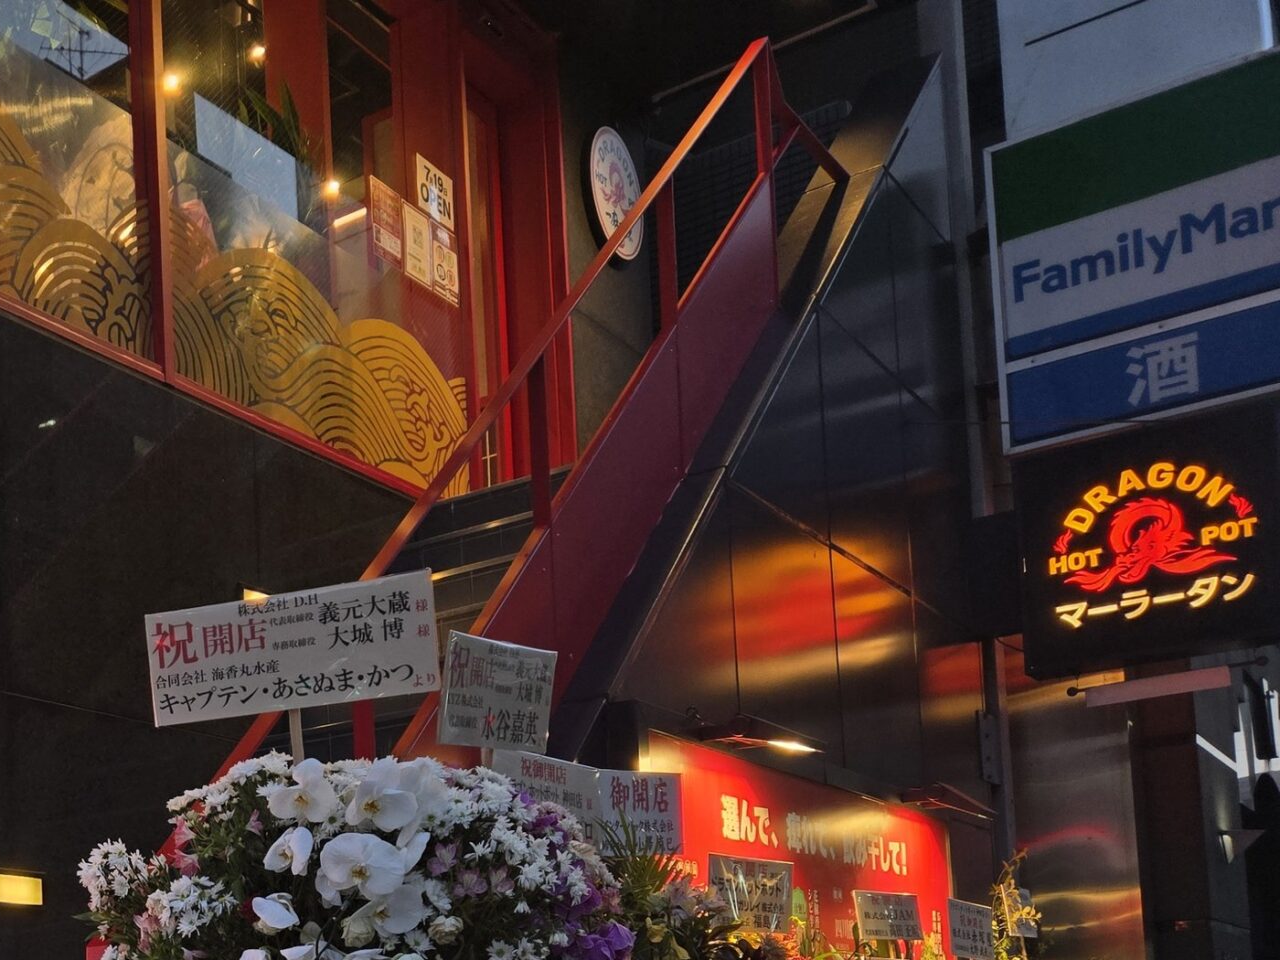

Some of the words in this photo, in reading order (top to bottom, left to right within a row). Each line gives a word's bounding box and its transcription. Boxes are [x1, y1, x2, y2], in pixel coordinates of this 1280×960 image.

[420, 182, 451, 221] OPEN
[1127, 332, 1200, 406] 酒
[1062, 462, 1235, 535] DRAGON
[1048, 548, 1102, 575] HOT
[1200, 517, 1258, 546] POT
[238, 598, 288, 617] 株式会社
[1055, 573, 1255, 628] マーラータン
